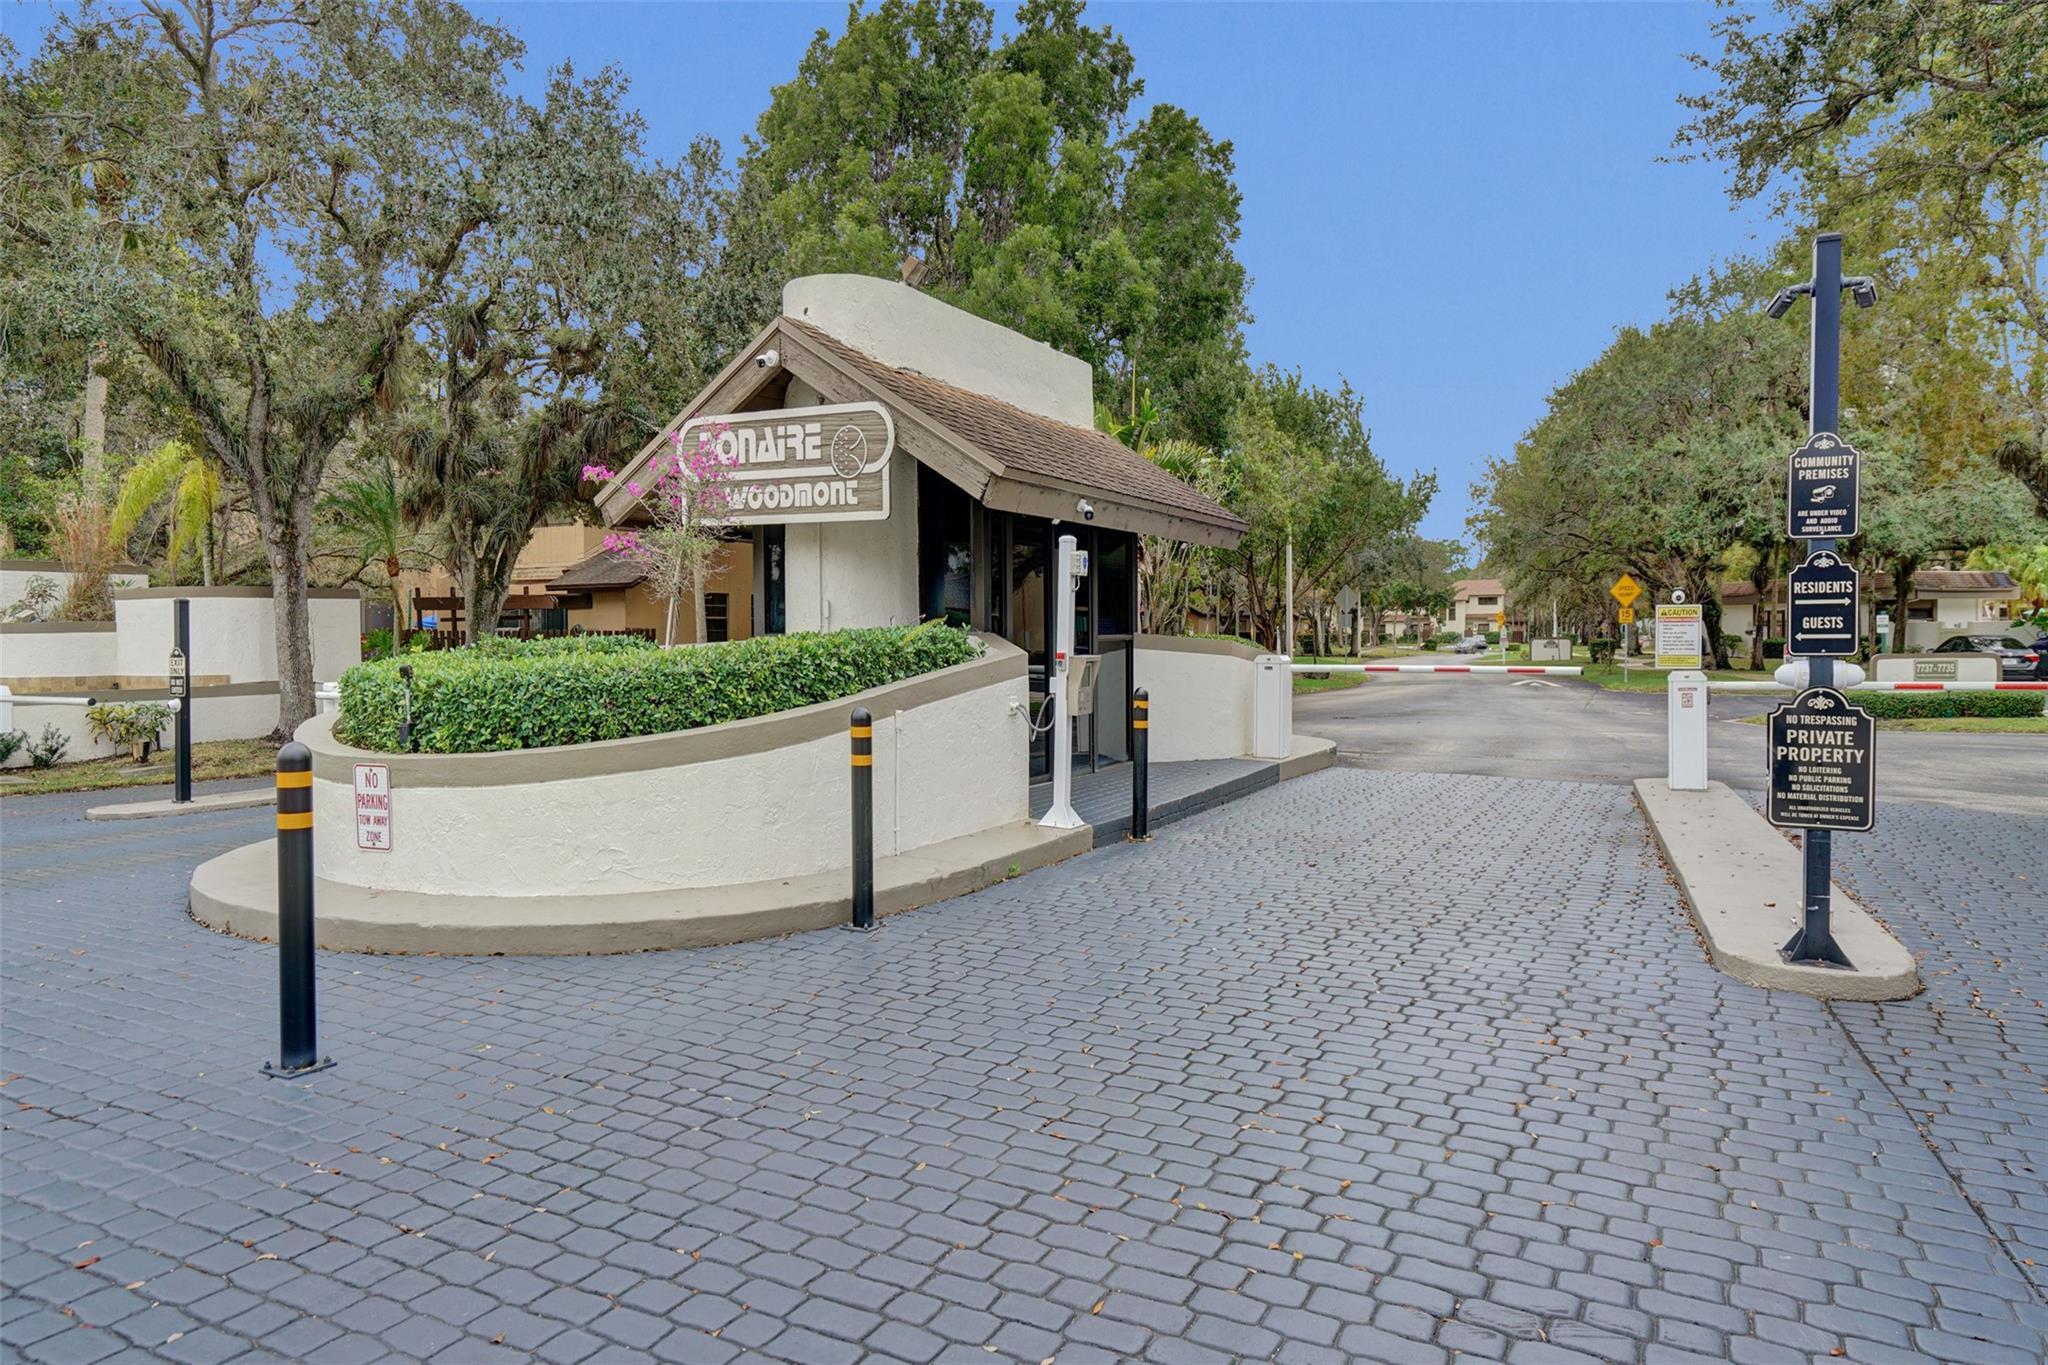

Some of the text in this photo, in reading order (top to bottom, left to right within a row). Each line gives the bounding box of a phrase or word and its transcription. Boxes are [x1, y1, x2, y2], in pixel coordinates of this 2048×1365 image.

[699, 423, 821, 464] ONAIRE
[1794, 455, 1854, 468] COMMUNITY
[1798, 468, 1849, 480] PREMISES
[1794, 580, 1853, 594] RESIDENTS
[1802, 616, 1844, 629] GUESTS
[170, 667, 184, 675] ONLY
[1786, 714, 1858, 726] NO TRESPASSING
[1786, 729, 1854, 746] PRIVATE
[1776, 746, 1864, 764] PROPERTY
[1808, 766, 1842, 775] LOITERING
[364, 772, 378, 788] NO
[1799, 775, 1822, 783] PUBLIC
[1824, 776, 1852, 784] PARKING
[1802, 784, 1848, 793] SOLICITATIONS
[357, 794, 388, 810] PARKING
[1787, 792, 1817, 801] MATERIAL
[1818, 794, 1864, 803] DISTRIBUTION
[359, 814, 388, 826] TOW AWAY
[366, 830, 382, 842] ZONE
